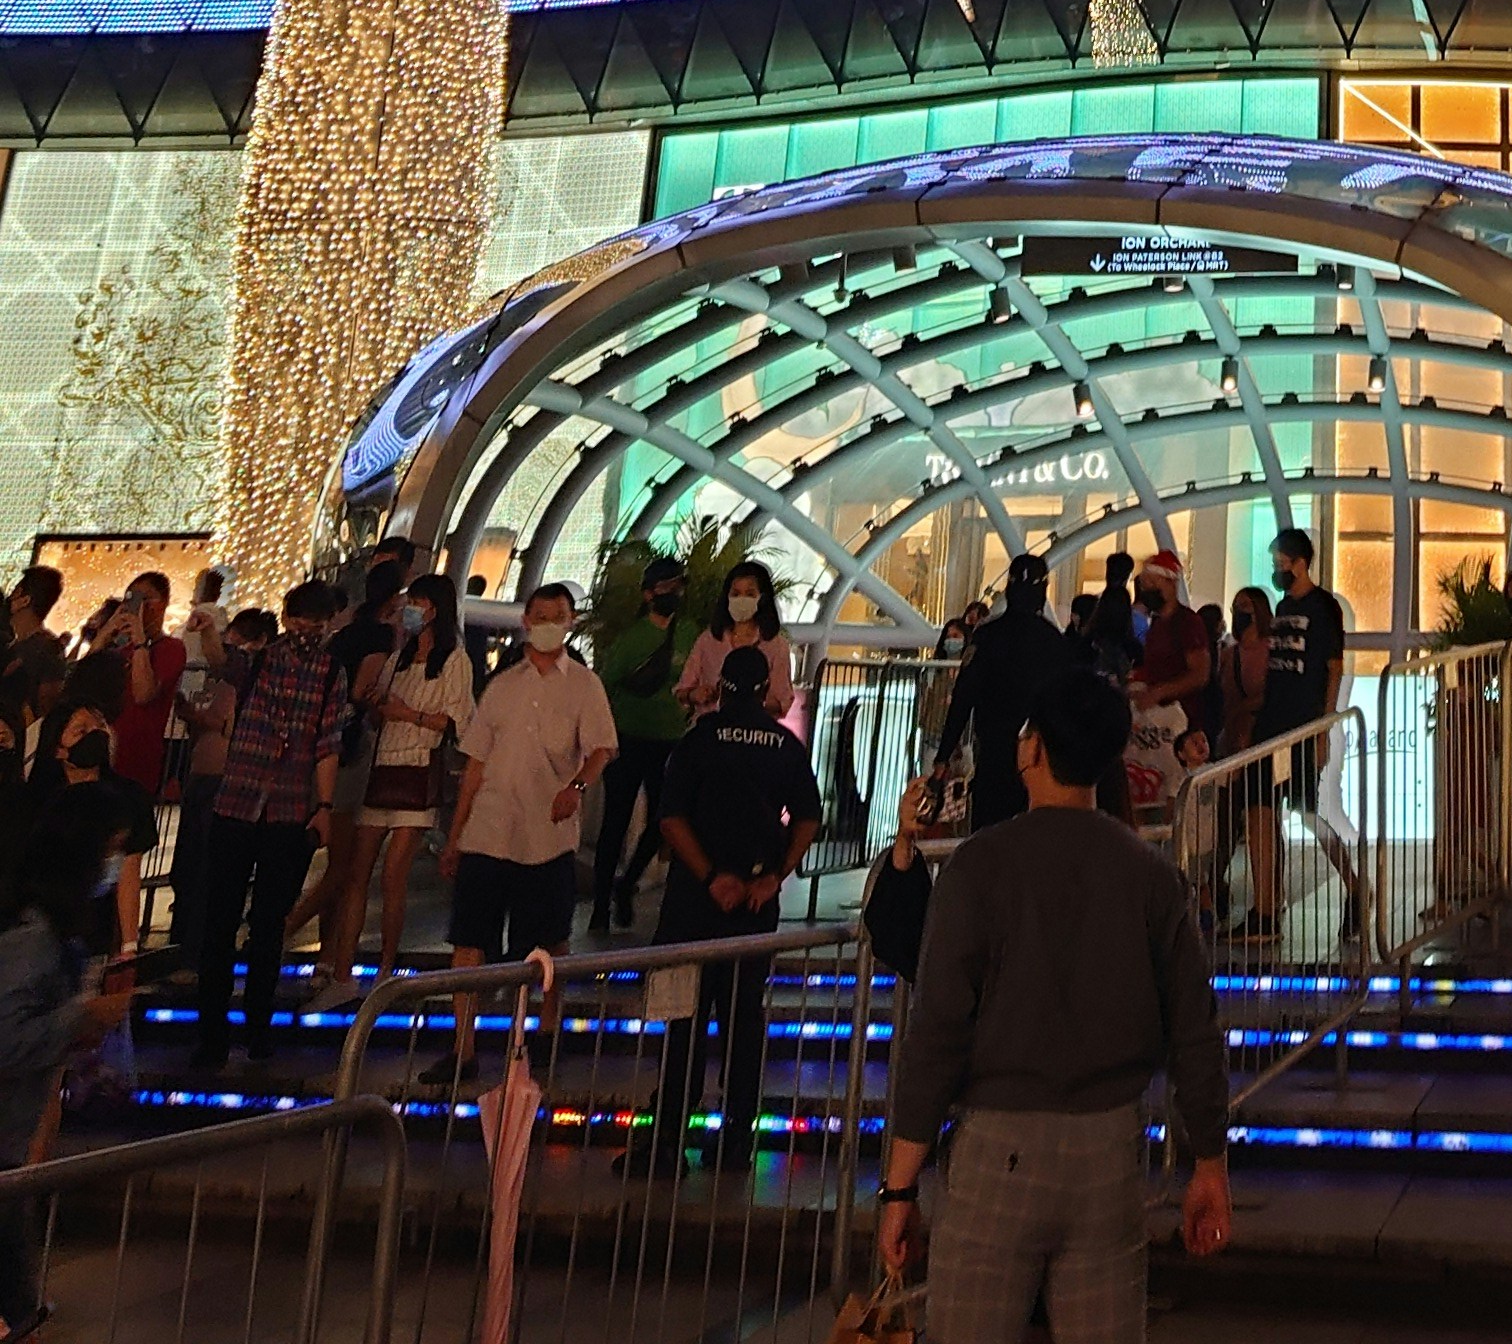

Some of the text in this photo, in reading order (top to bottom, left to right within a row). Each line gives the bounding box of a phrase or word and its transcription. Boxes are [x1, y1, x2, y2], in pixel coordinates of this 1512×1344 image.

[1121, 236, 1146, 250] ION
[1113, 252, 1130, 262] ION
[1131, 251, 1180, 262] PATERSON
[1181, 251, 1202, 262] LINK
[1124, 261, 1166, 272] Wheelock
